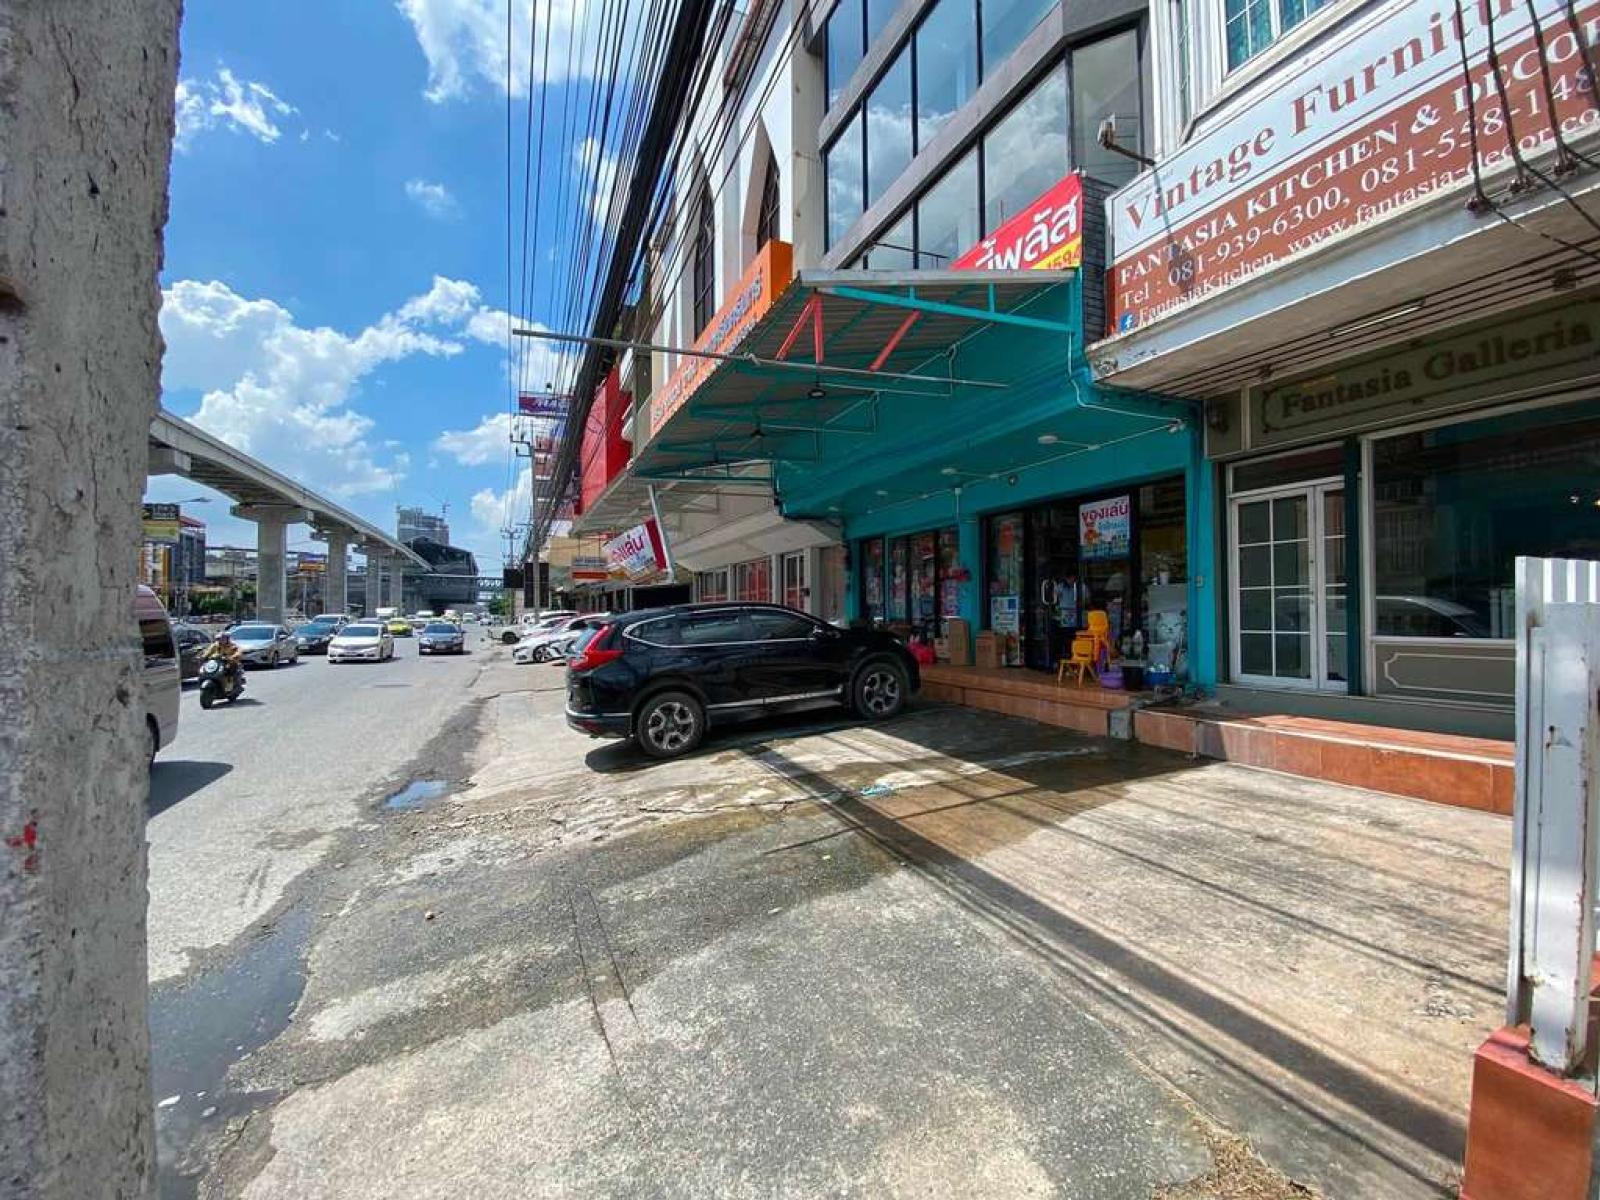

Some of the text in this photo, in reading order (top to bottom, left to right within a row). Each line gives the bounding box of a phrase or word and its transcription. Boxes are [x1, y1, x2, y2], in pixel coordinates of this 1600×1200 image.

[1120, 211, 1238, 286] FANTASIA
[1247, 119, 1399, 220] KITCHEN
[1410, 105, 1442, 135] &
[1126, 127, 1275, 230] Vintage
[1121, 281, 1149, 309] Tel
[1281, 320, 1592, 418] Fantasia Galleria
